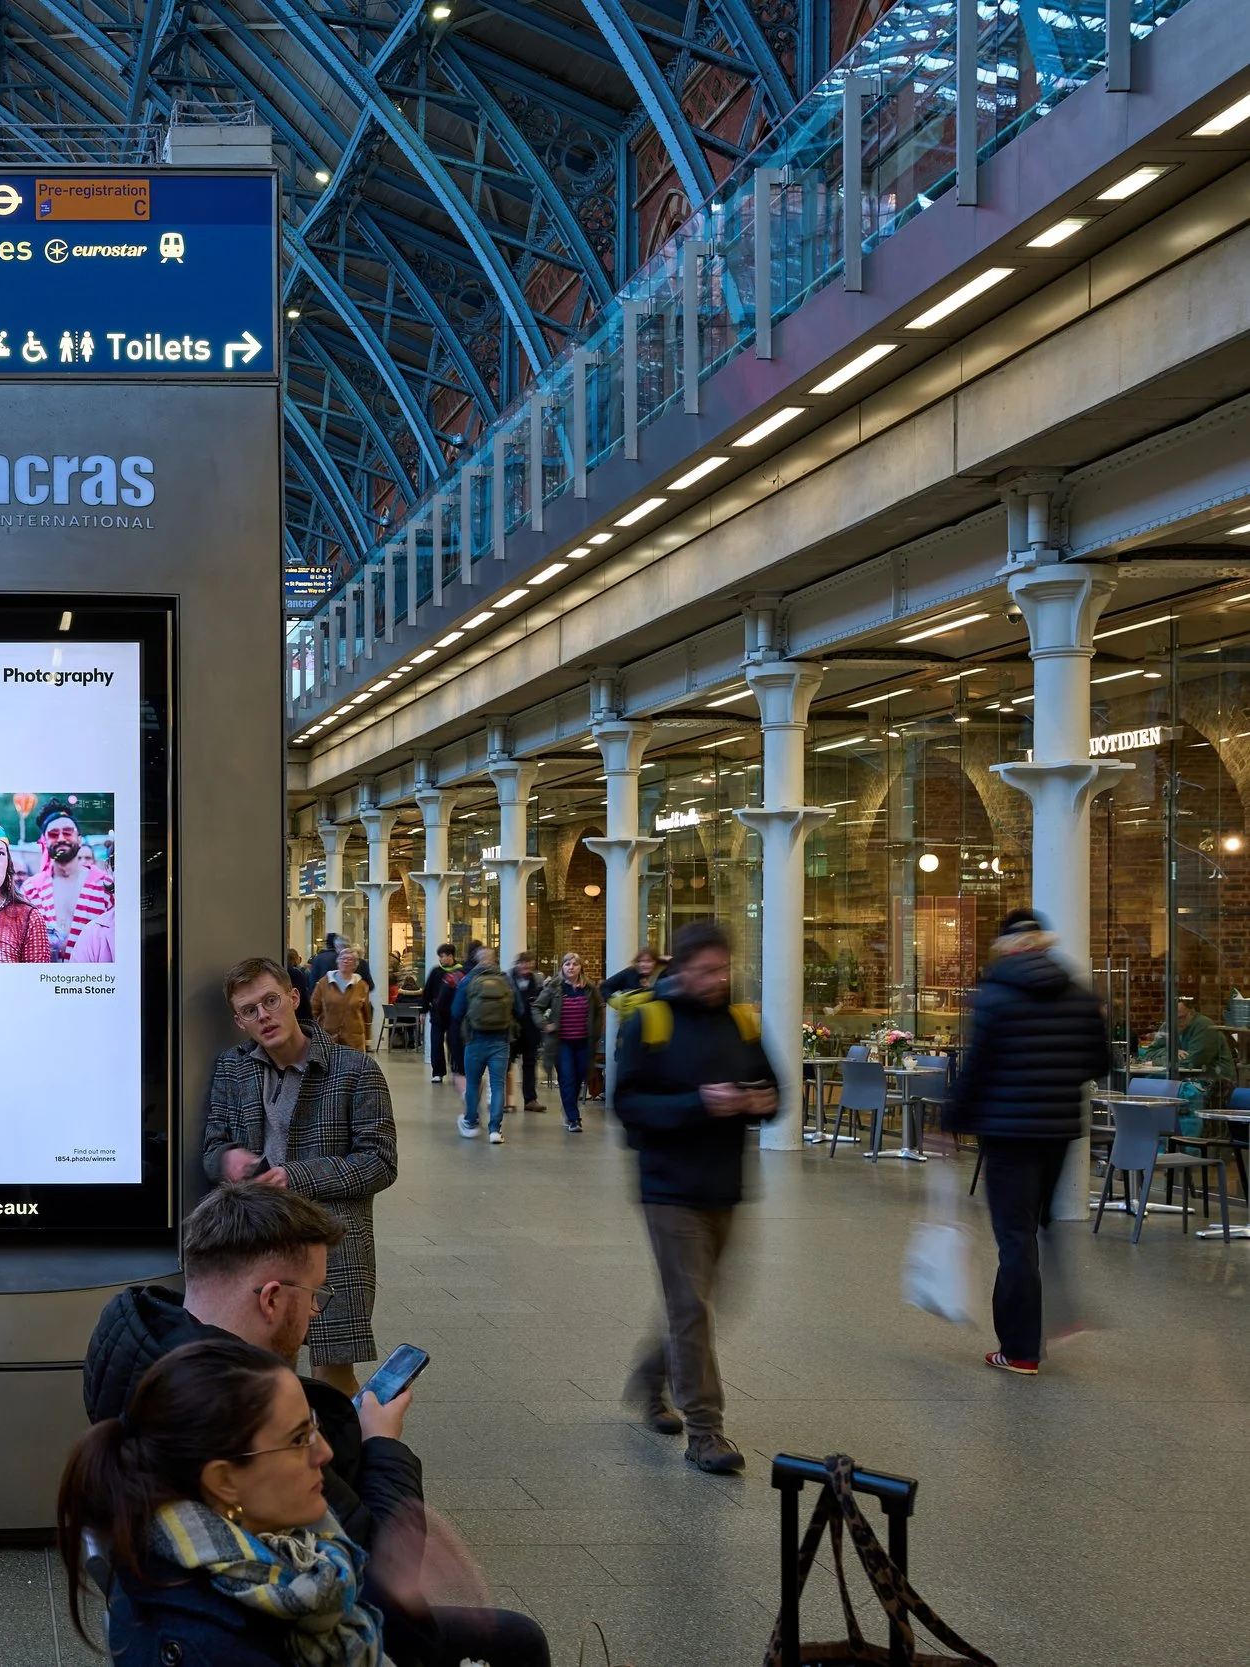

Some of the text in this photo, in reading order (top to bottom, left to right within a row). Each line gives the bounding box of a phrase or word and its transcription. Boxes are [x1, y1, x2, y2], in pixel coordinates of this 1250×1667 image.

[38, 184, 147, 199] Pre-registration
[134, 199, 147, 216] C
[72, 243, 148, 258] eurostar
[106, 333, 211, 361] Toilets
[3, 667, 114, 687] Photography
[1089, 726, 1162, 757] UOTIDIEN
[40, 973, 116, 984] Photographed by
[54, 985, 116, 994] Emma Stoner
